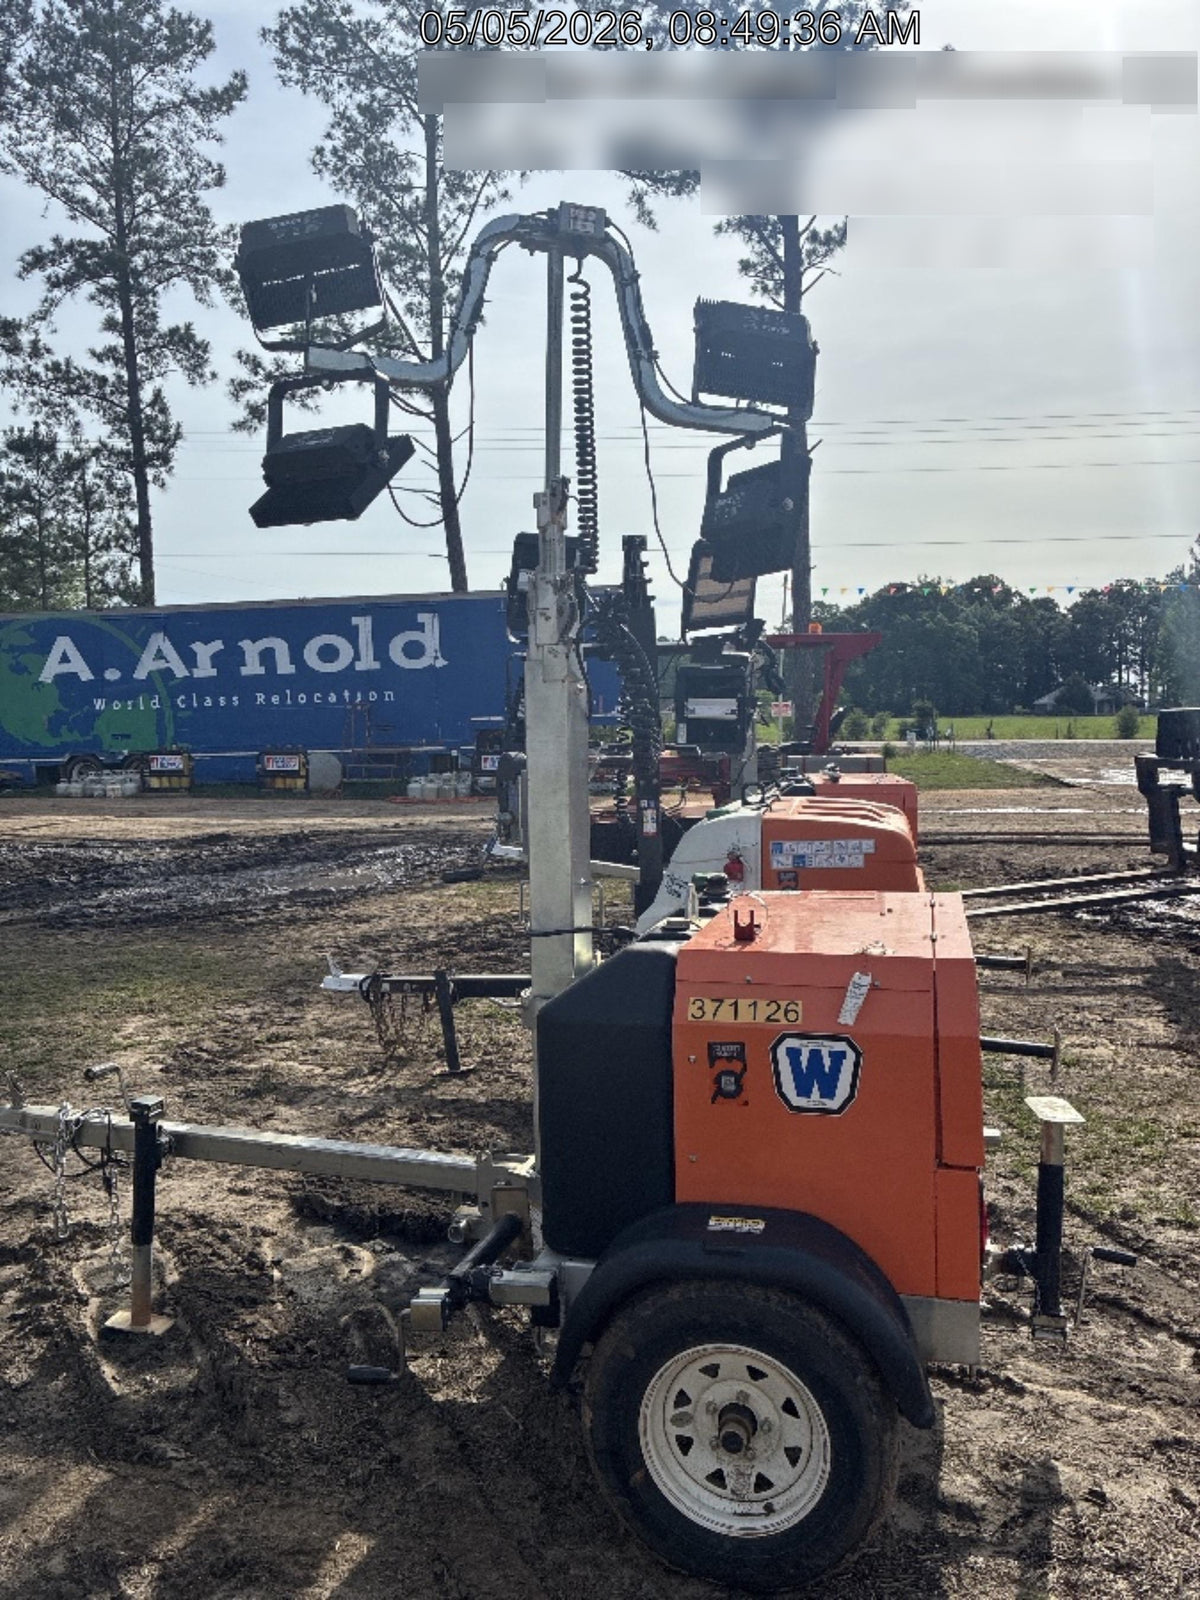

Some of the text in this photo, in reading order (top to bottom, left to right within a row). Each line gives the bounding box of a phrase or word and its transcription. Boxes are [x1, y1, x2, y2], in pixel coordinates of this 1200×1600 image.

[92, 687, 397, 712] World Class Relocation
[690, 998, 800, 1023] 371126
